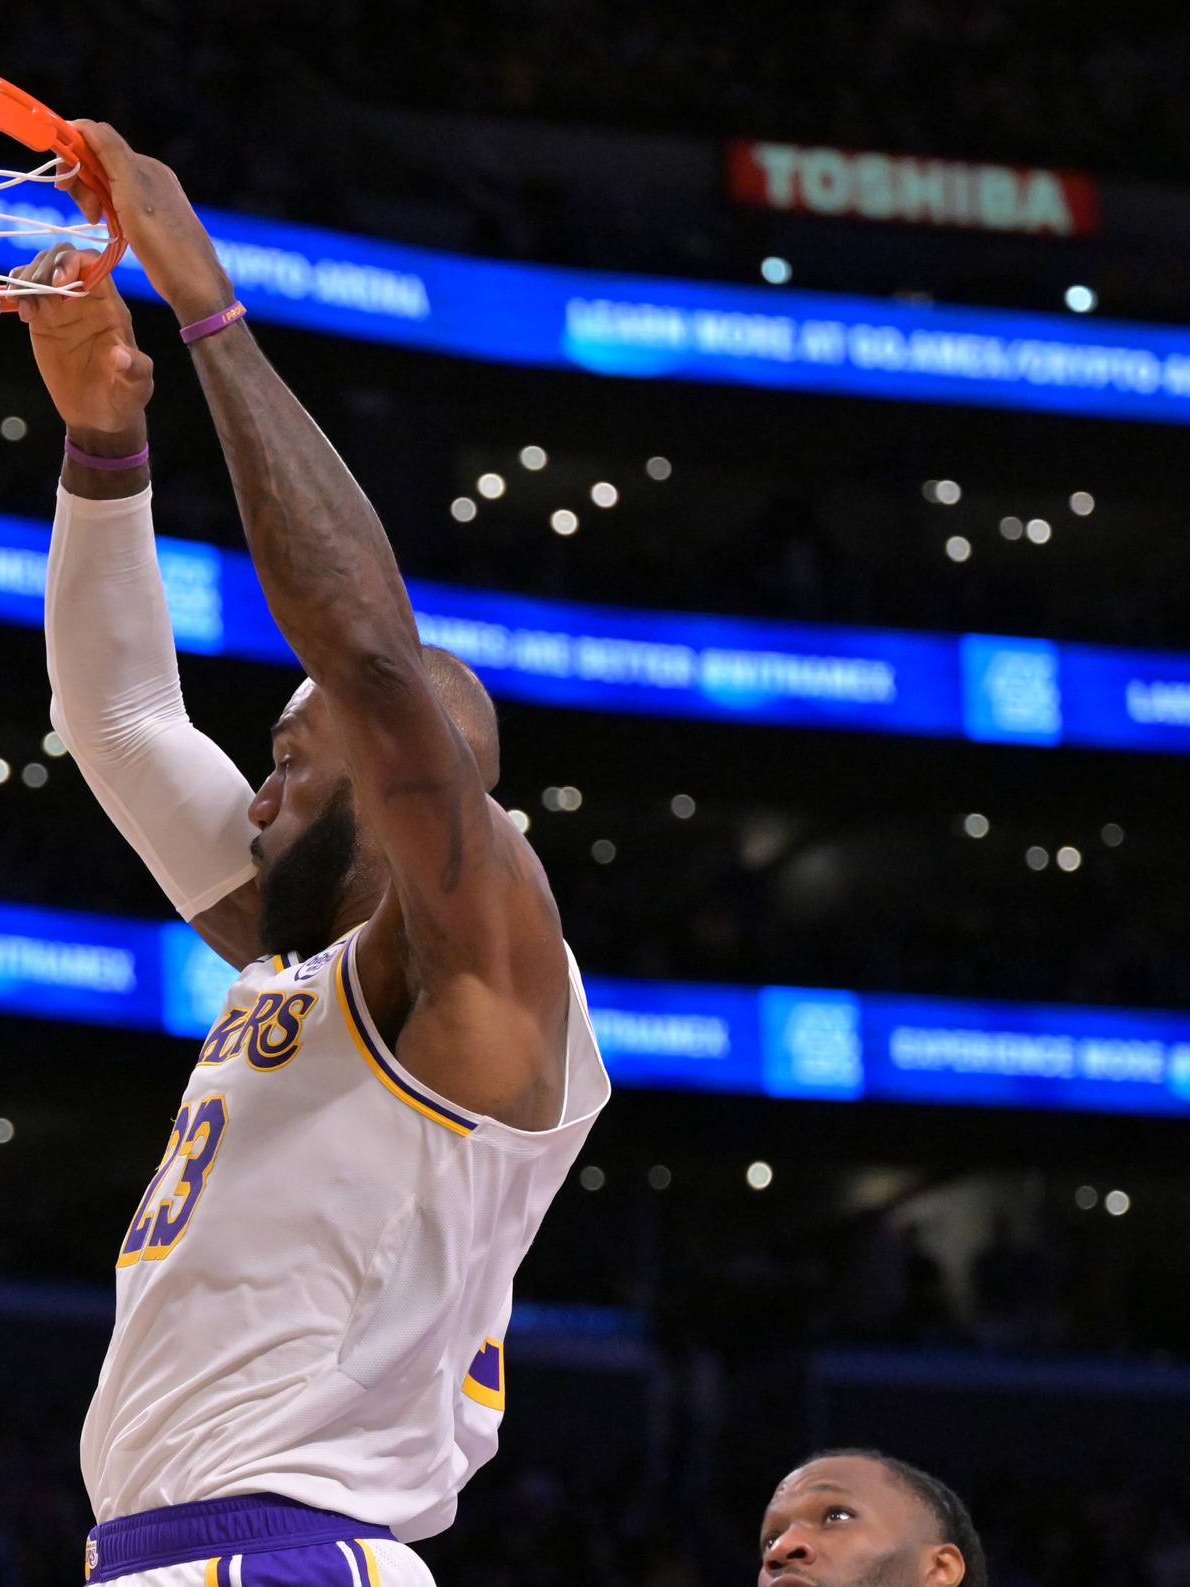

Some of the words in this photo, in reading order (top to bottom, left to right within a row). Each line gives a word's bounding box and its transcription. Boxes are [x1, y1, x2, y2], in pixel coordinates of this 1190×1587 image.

[753, 142, 1074, 237] TOSHIBA
[889, 1024, 1075, 1080] EXPERIENCE
[1076, 1036, 1164, 1084] MORE
[115, 1094, 230, 1270] 23
